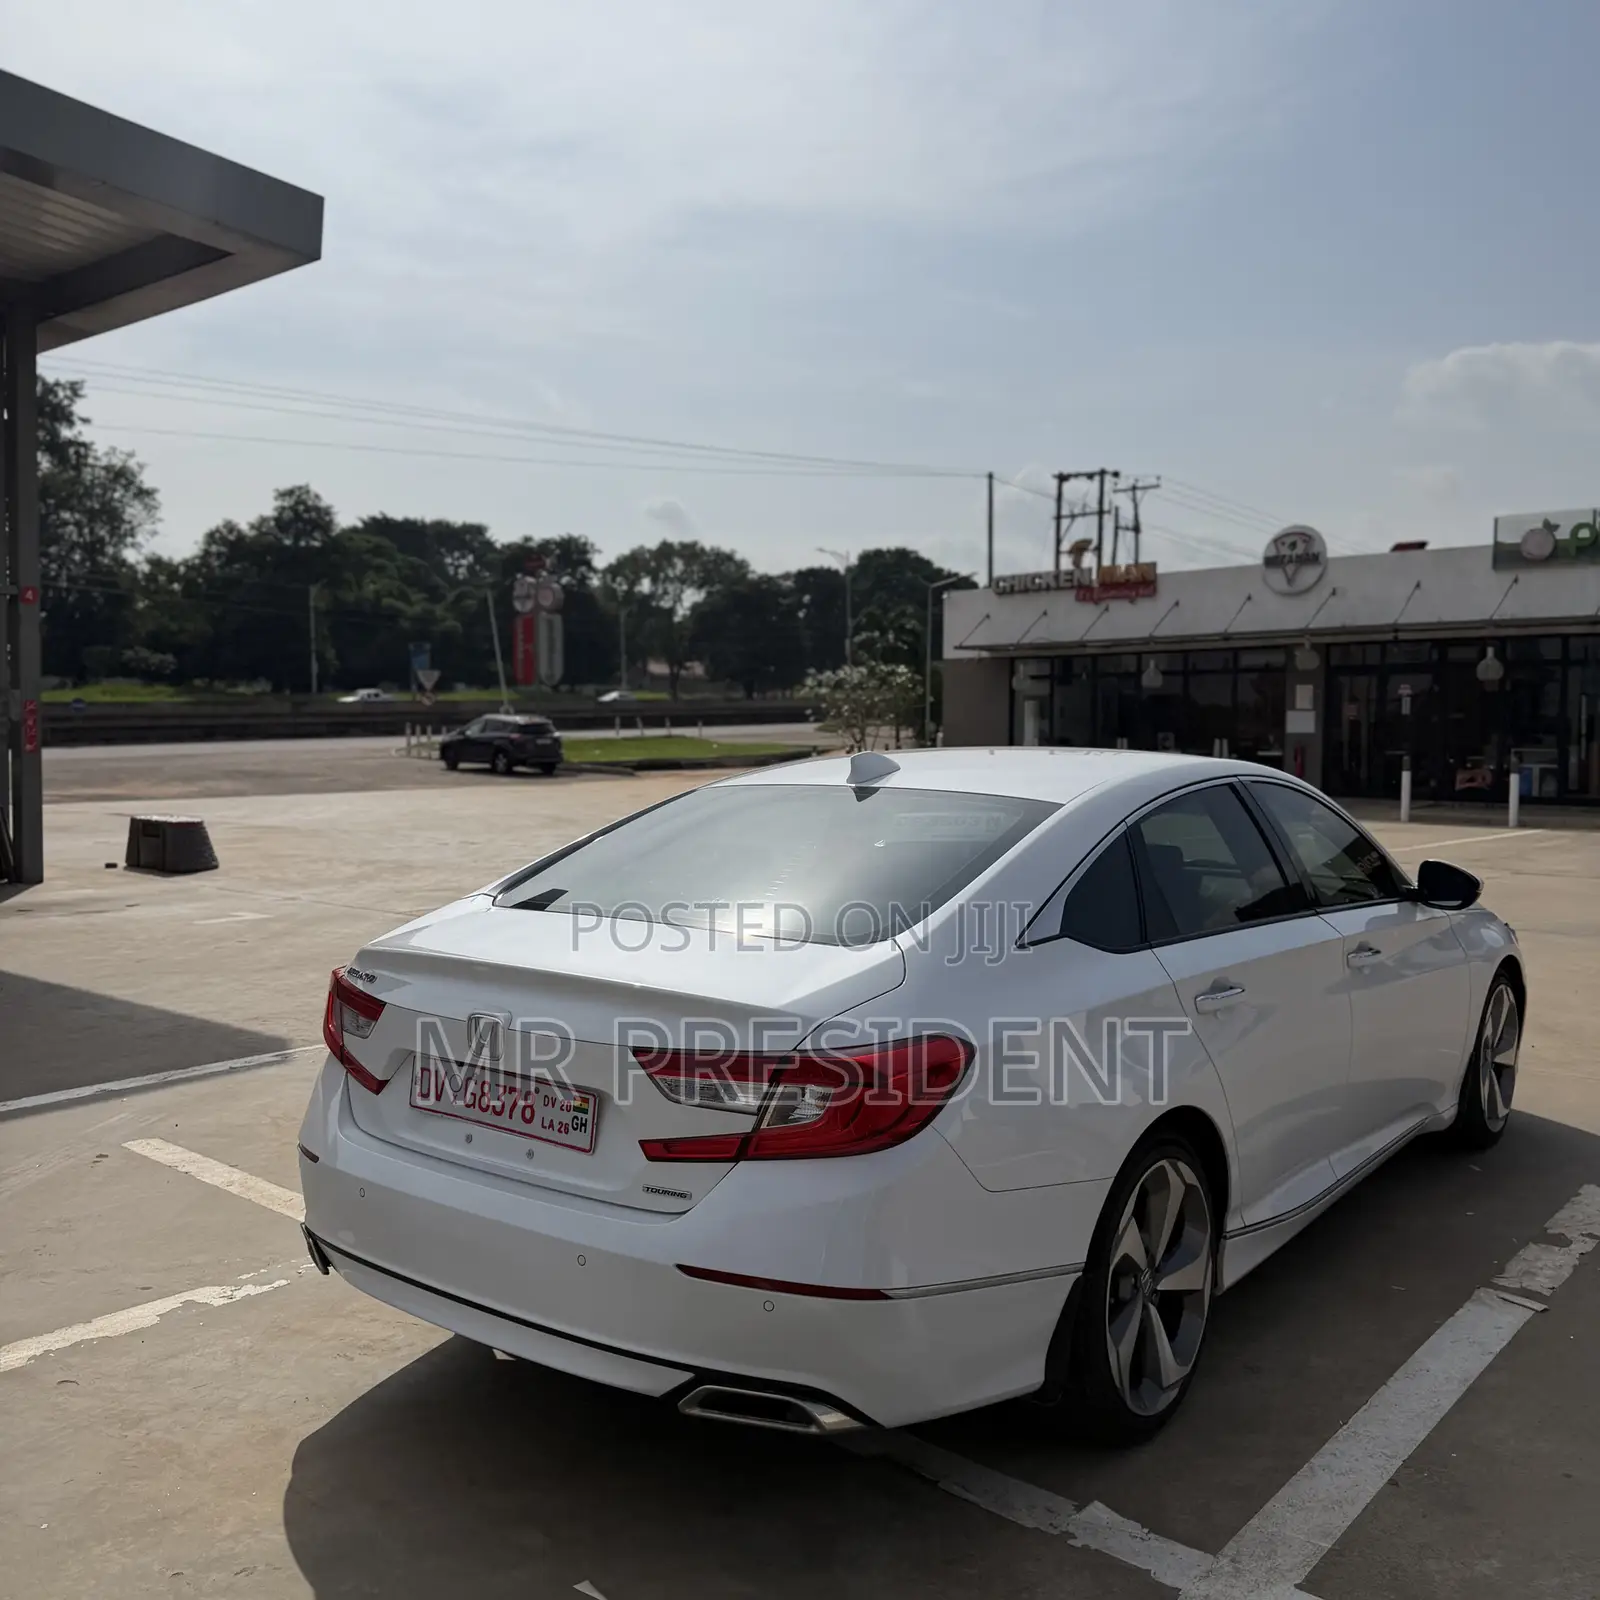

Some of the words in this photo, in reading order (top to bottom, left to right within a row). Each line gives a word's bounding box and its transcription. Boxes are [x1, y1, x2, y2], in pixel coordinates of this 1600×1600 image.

[992, 568, 1092, 595] CHICKEN
[1099, 562, 1157, 585] MAN
[421, 1067, 447, 1102] DV
[543, 1094, 557, 1109] DV
[541, 1116, 555, 1132] LA
[571, 1115, 588, 1134] GH
[645, 1186, 687, 1198] TOURING
